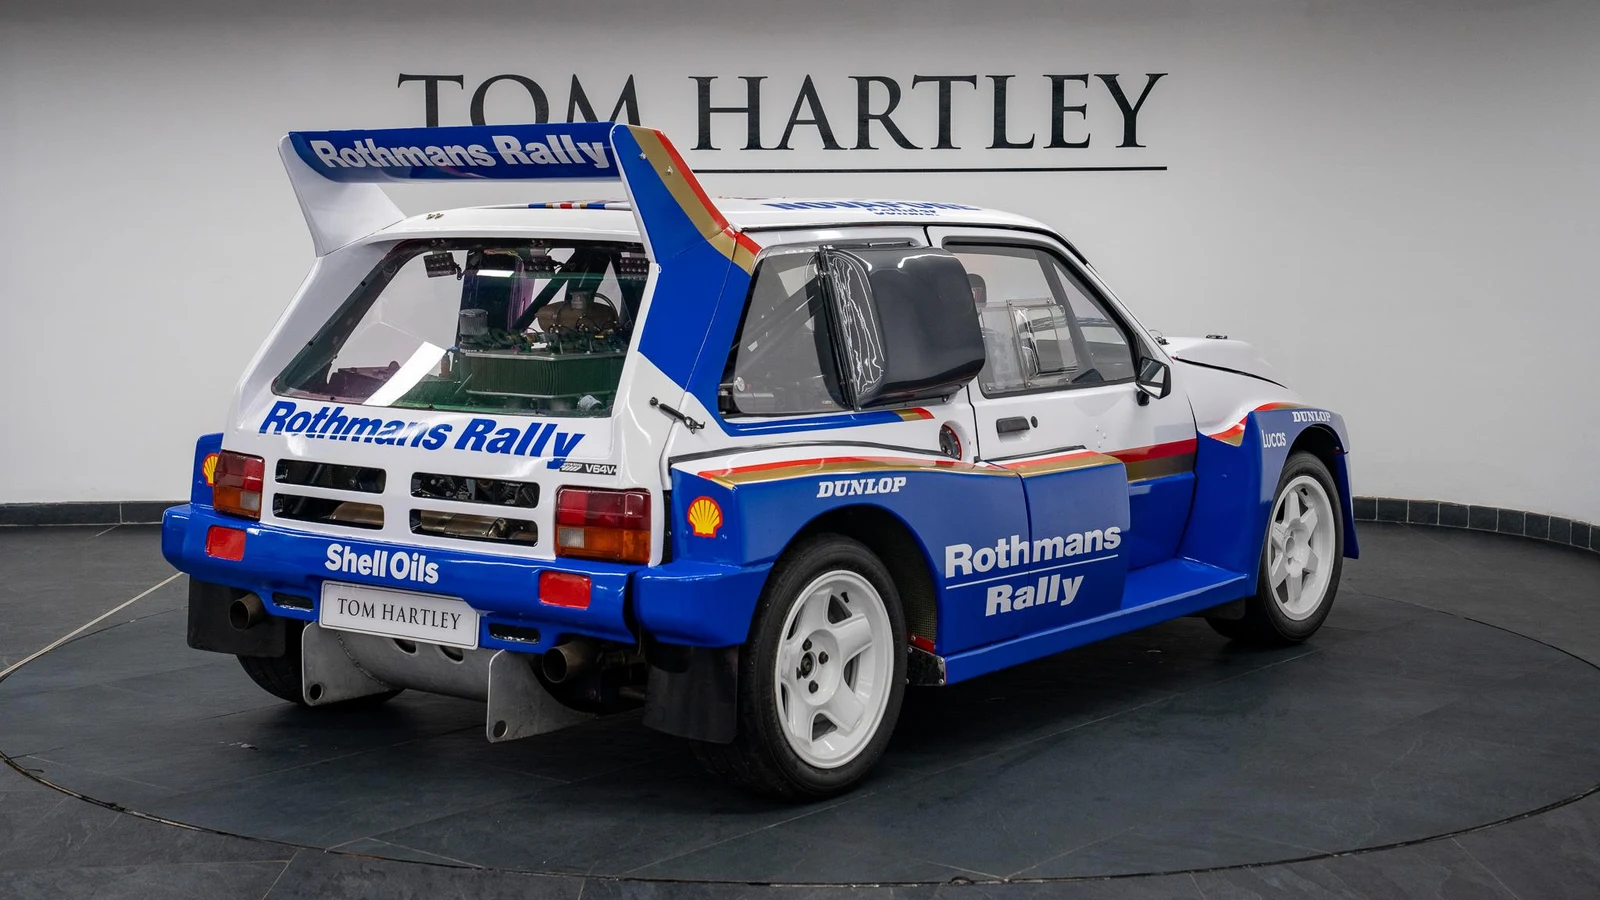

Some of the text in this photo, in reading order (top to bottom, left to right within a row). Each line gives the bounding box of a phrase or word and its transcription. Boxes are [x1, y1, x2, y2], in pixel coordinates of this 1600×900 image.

[397, 72, 1169, 151] TOM HARTLEY
[309, 134, 610, 169] Rothmans Rally
[259, 400, 586, 470] Rothmans Rally
[1292, 410, 1332, 423] DUNLOP
[816, 476, 907, 499] DUNLOP
[324, 543, 439, 585] Shell Oils
[945, 526, 1122, 579] Rothmans
[337, 597, 462, 631] TOM HARTLEY
[985, 574, 1084, 617] Rally
